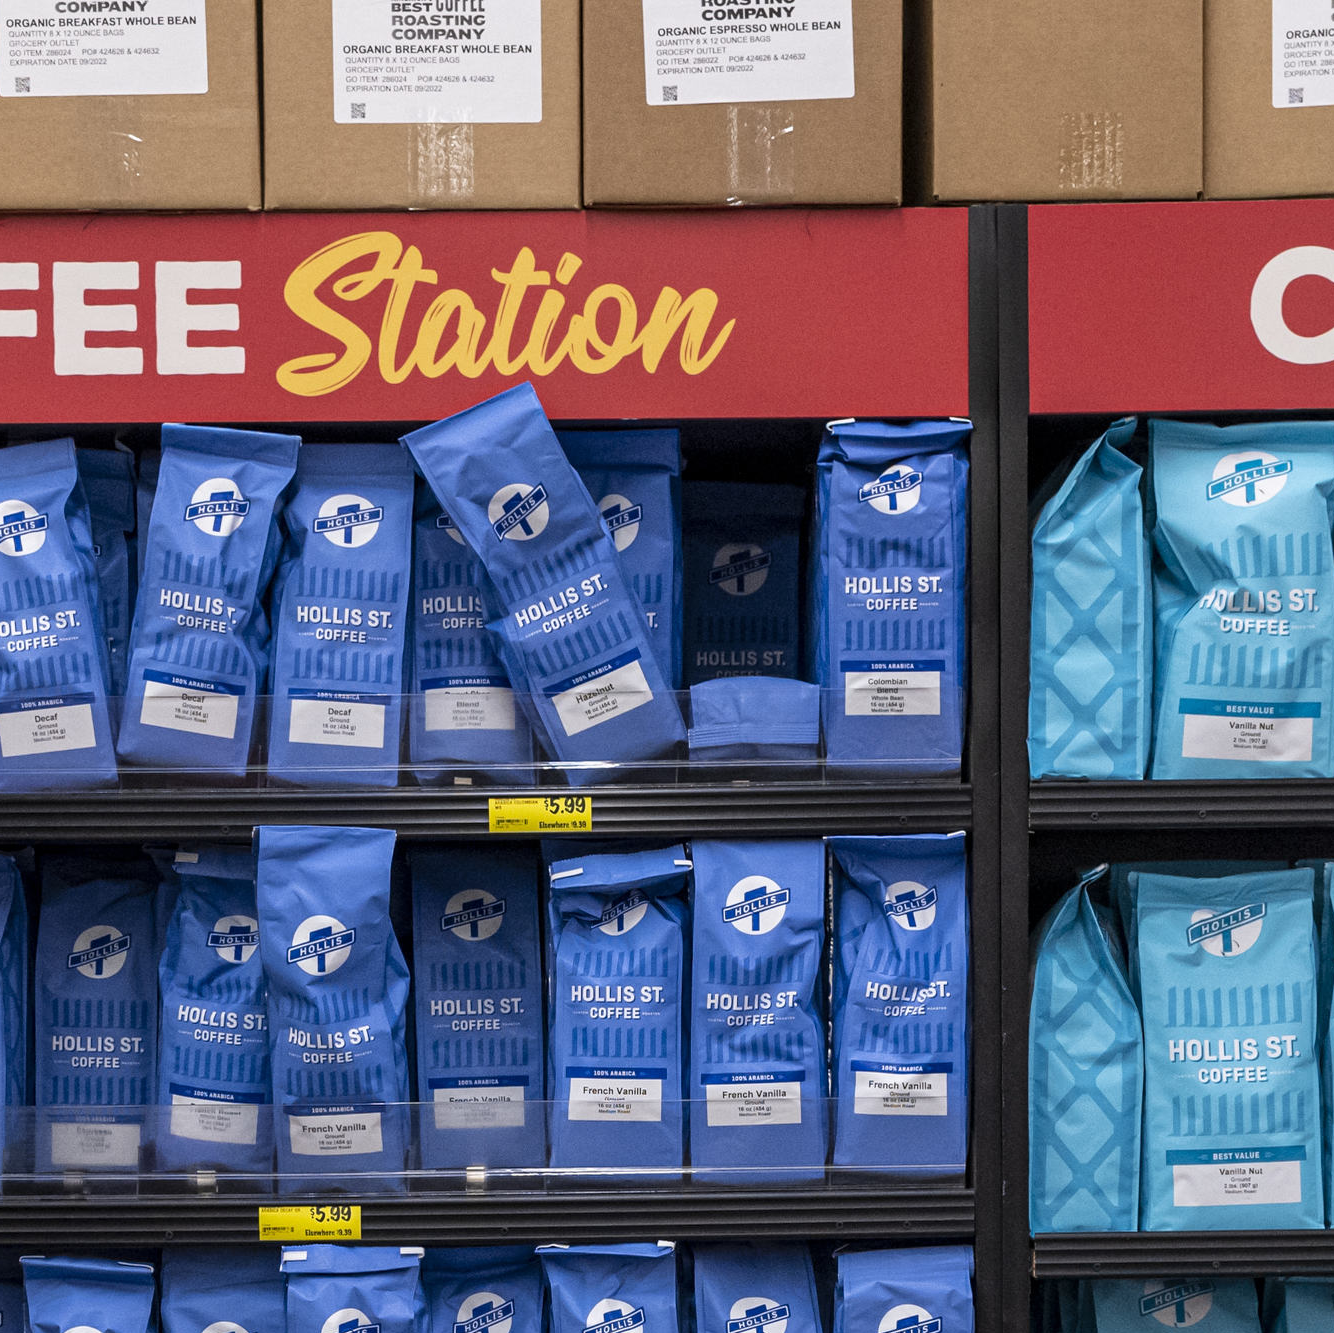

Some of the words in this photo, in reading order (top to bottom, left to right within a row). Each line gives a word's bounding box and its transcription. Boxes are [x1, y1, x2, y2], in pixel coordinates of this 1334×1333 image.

[391, 3, 432, 12] BEST
[702, 7, 795, 21] COMPANY
[6, 19, 55, 28] ORGANIC
[59, 18, 122, 27] BREAKFAST
[125, 17, 164, 26] WHOLE
[167, 16, 196, 25] BEAN
[392, 15, 485, 26] ROASTING
[392, 29, 485, 40] COMPANY
[658, 27, 706, 36] ORGANIC
[710, 25, 766, 35] ESPRESSO
[770, 23, 808, 32] WHOLE
[812, 21, 841, 30] BEAN
[343, 45, 391, 54] ORGANIC
[396, 45, 459, 53] BREAKFAST
[462, 45, 500, 53] WHOLE
[503, 45, 532, 53] BEAN
[276, 231, 736, 397] Station
[844, 575, 903, 595] HOLLIS
[909, 575, 943, 595] ST.
[55, 609, 81, 632] ST.
[35, 713, 57, 722] Decaf
[571, 984, 633, 1004] HOLLIS
[638, 984, 665, 1004] ST.
[1169, 1037, 1259, 1064] HOLLIS
[1265, 1034, 1301, 1059] ST.
[1198, 1065, 1268, 1085] COFFEE
[583, 1087, 613, 1095] French
[1219, 1168, 1246, 1176] Vanilla
